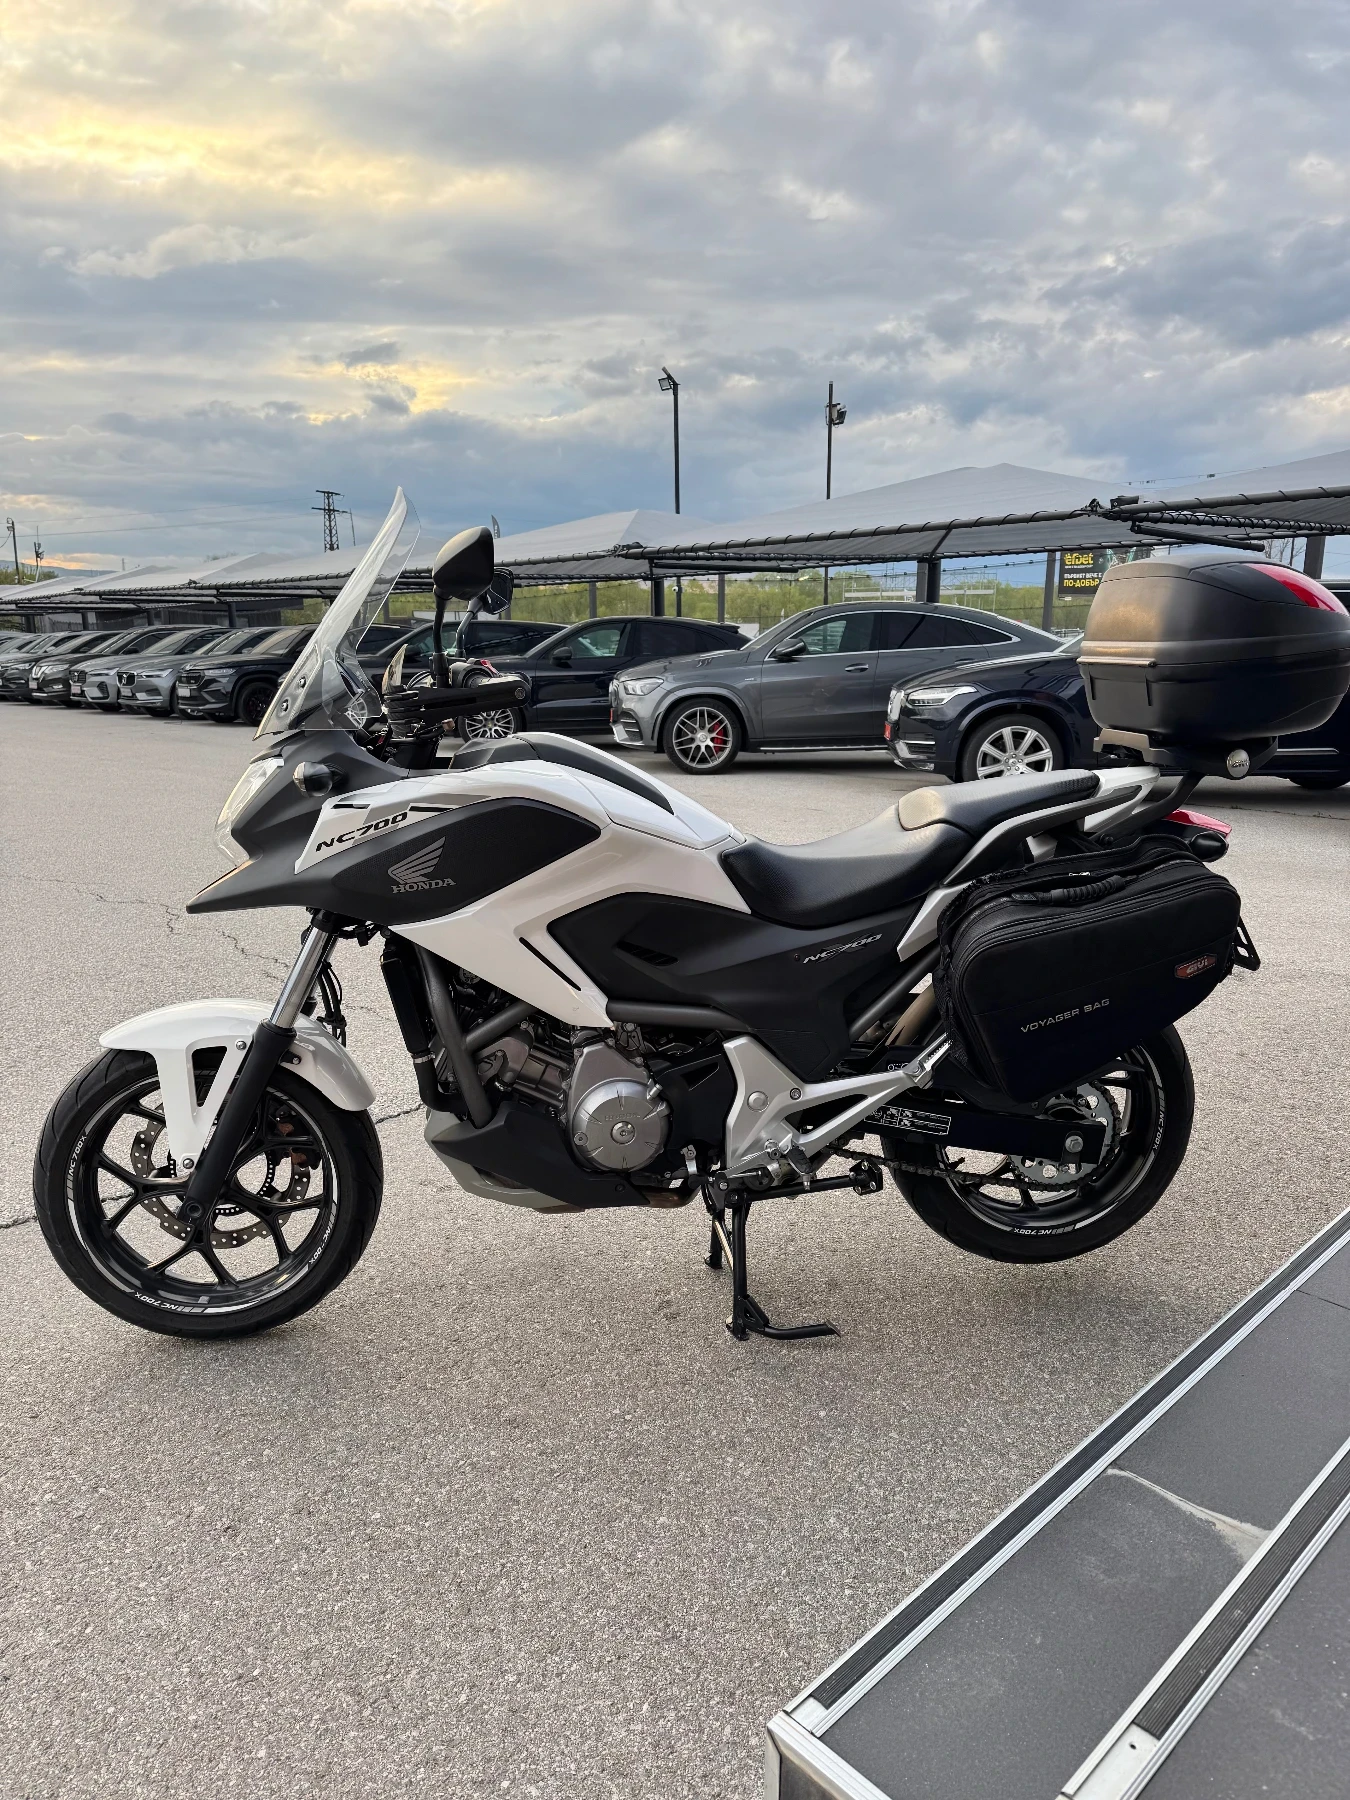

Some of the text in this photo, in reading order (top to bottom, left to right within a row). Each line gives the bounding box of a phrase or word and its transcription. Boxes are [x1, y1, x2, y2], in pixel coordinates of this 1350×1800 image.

[1064, 553, 1094, 565] efbet
[1063, 579, 1100, 588] ПО-ДОБЪР
[315, 811, 409, 852] NC700
[391, 878, 457, 894] HONDA
[1020, 998, 1110, 1033] VOYAGER BAG
[134, 1291, 179, 1310] NC700X
